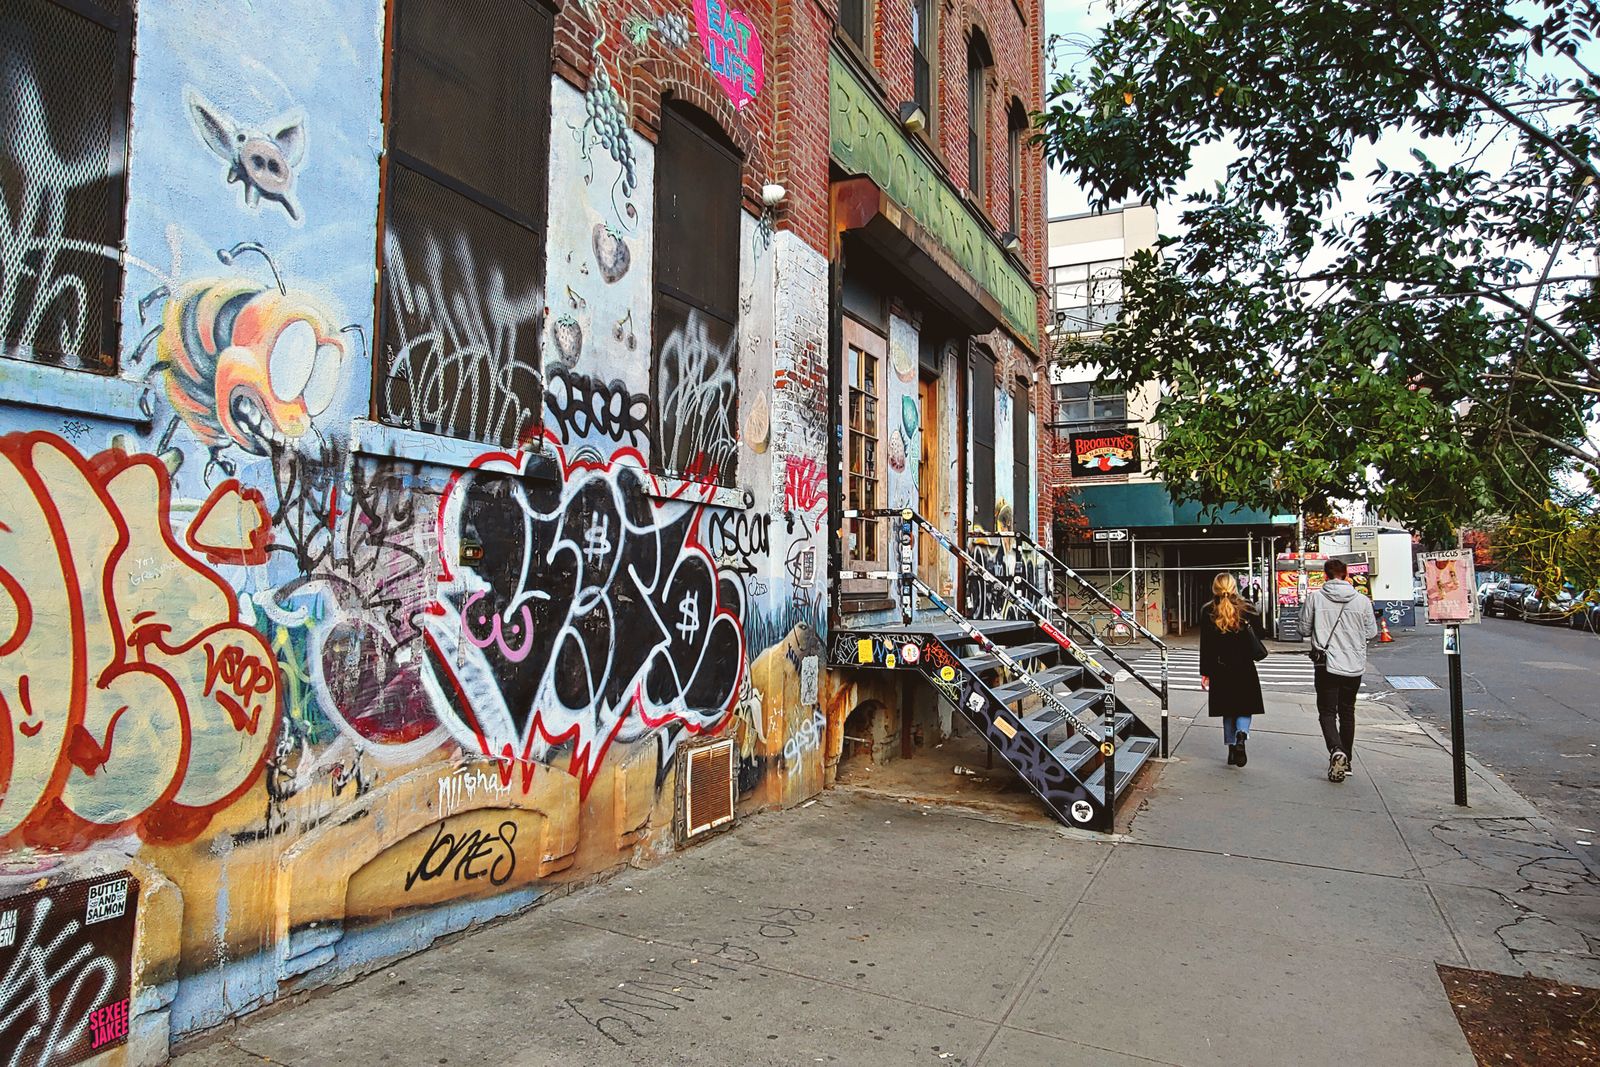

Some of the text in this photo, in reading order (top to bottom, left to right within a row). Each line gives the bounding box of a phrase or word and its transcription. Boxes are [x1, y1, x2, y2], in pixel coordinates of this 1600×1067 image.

[706, 0, 751, 57] EAT
[709, 38, 756, 97] LIFE
[1088, 447, 1120, 457] NATURAL
[90, 879, 127, 898] BUTTER
[98, 894, 117, 906] AND
[87, 900, 125, 921] SALMON
[89, 1000, 128, 1030] SEXEE
[91, 1016, 129, 1050] JAKEE
